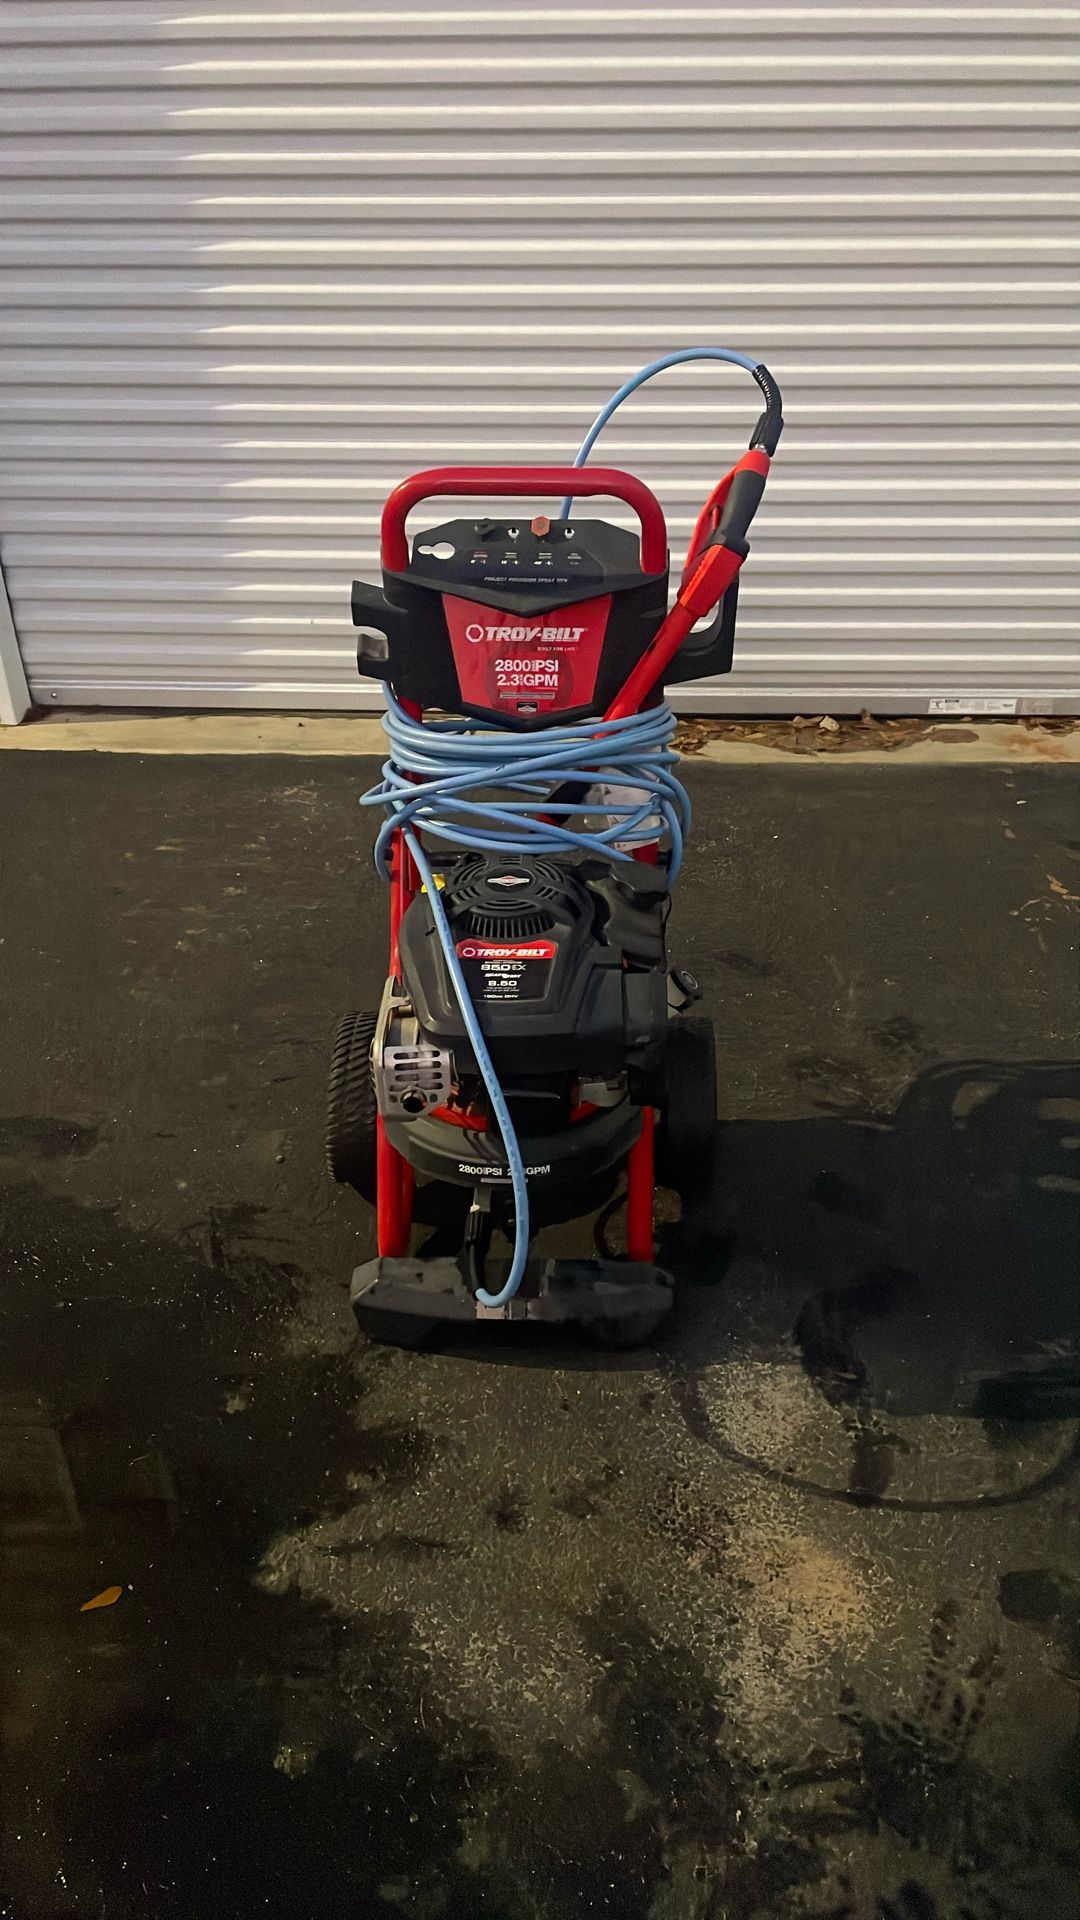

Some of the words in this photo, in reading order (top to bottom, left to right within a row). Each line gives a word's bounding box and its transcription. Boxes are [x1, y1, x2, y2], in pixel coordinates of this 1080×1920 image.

[486, 626, 585, 642] TROY-BILT
[495, 659, 531, 672] 2800
[535, 659, 559, 672] PSI
[497, 674, 520, 686] 2.3
[523, 674, 558, 687] GPM
[476, 948, 550, 957] TROY-BILT
[458, 1164, 482, 1175] 2800
[485, 1167, 502, 1176] PSI
[526, 1164, 551, 1175] GPM
